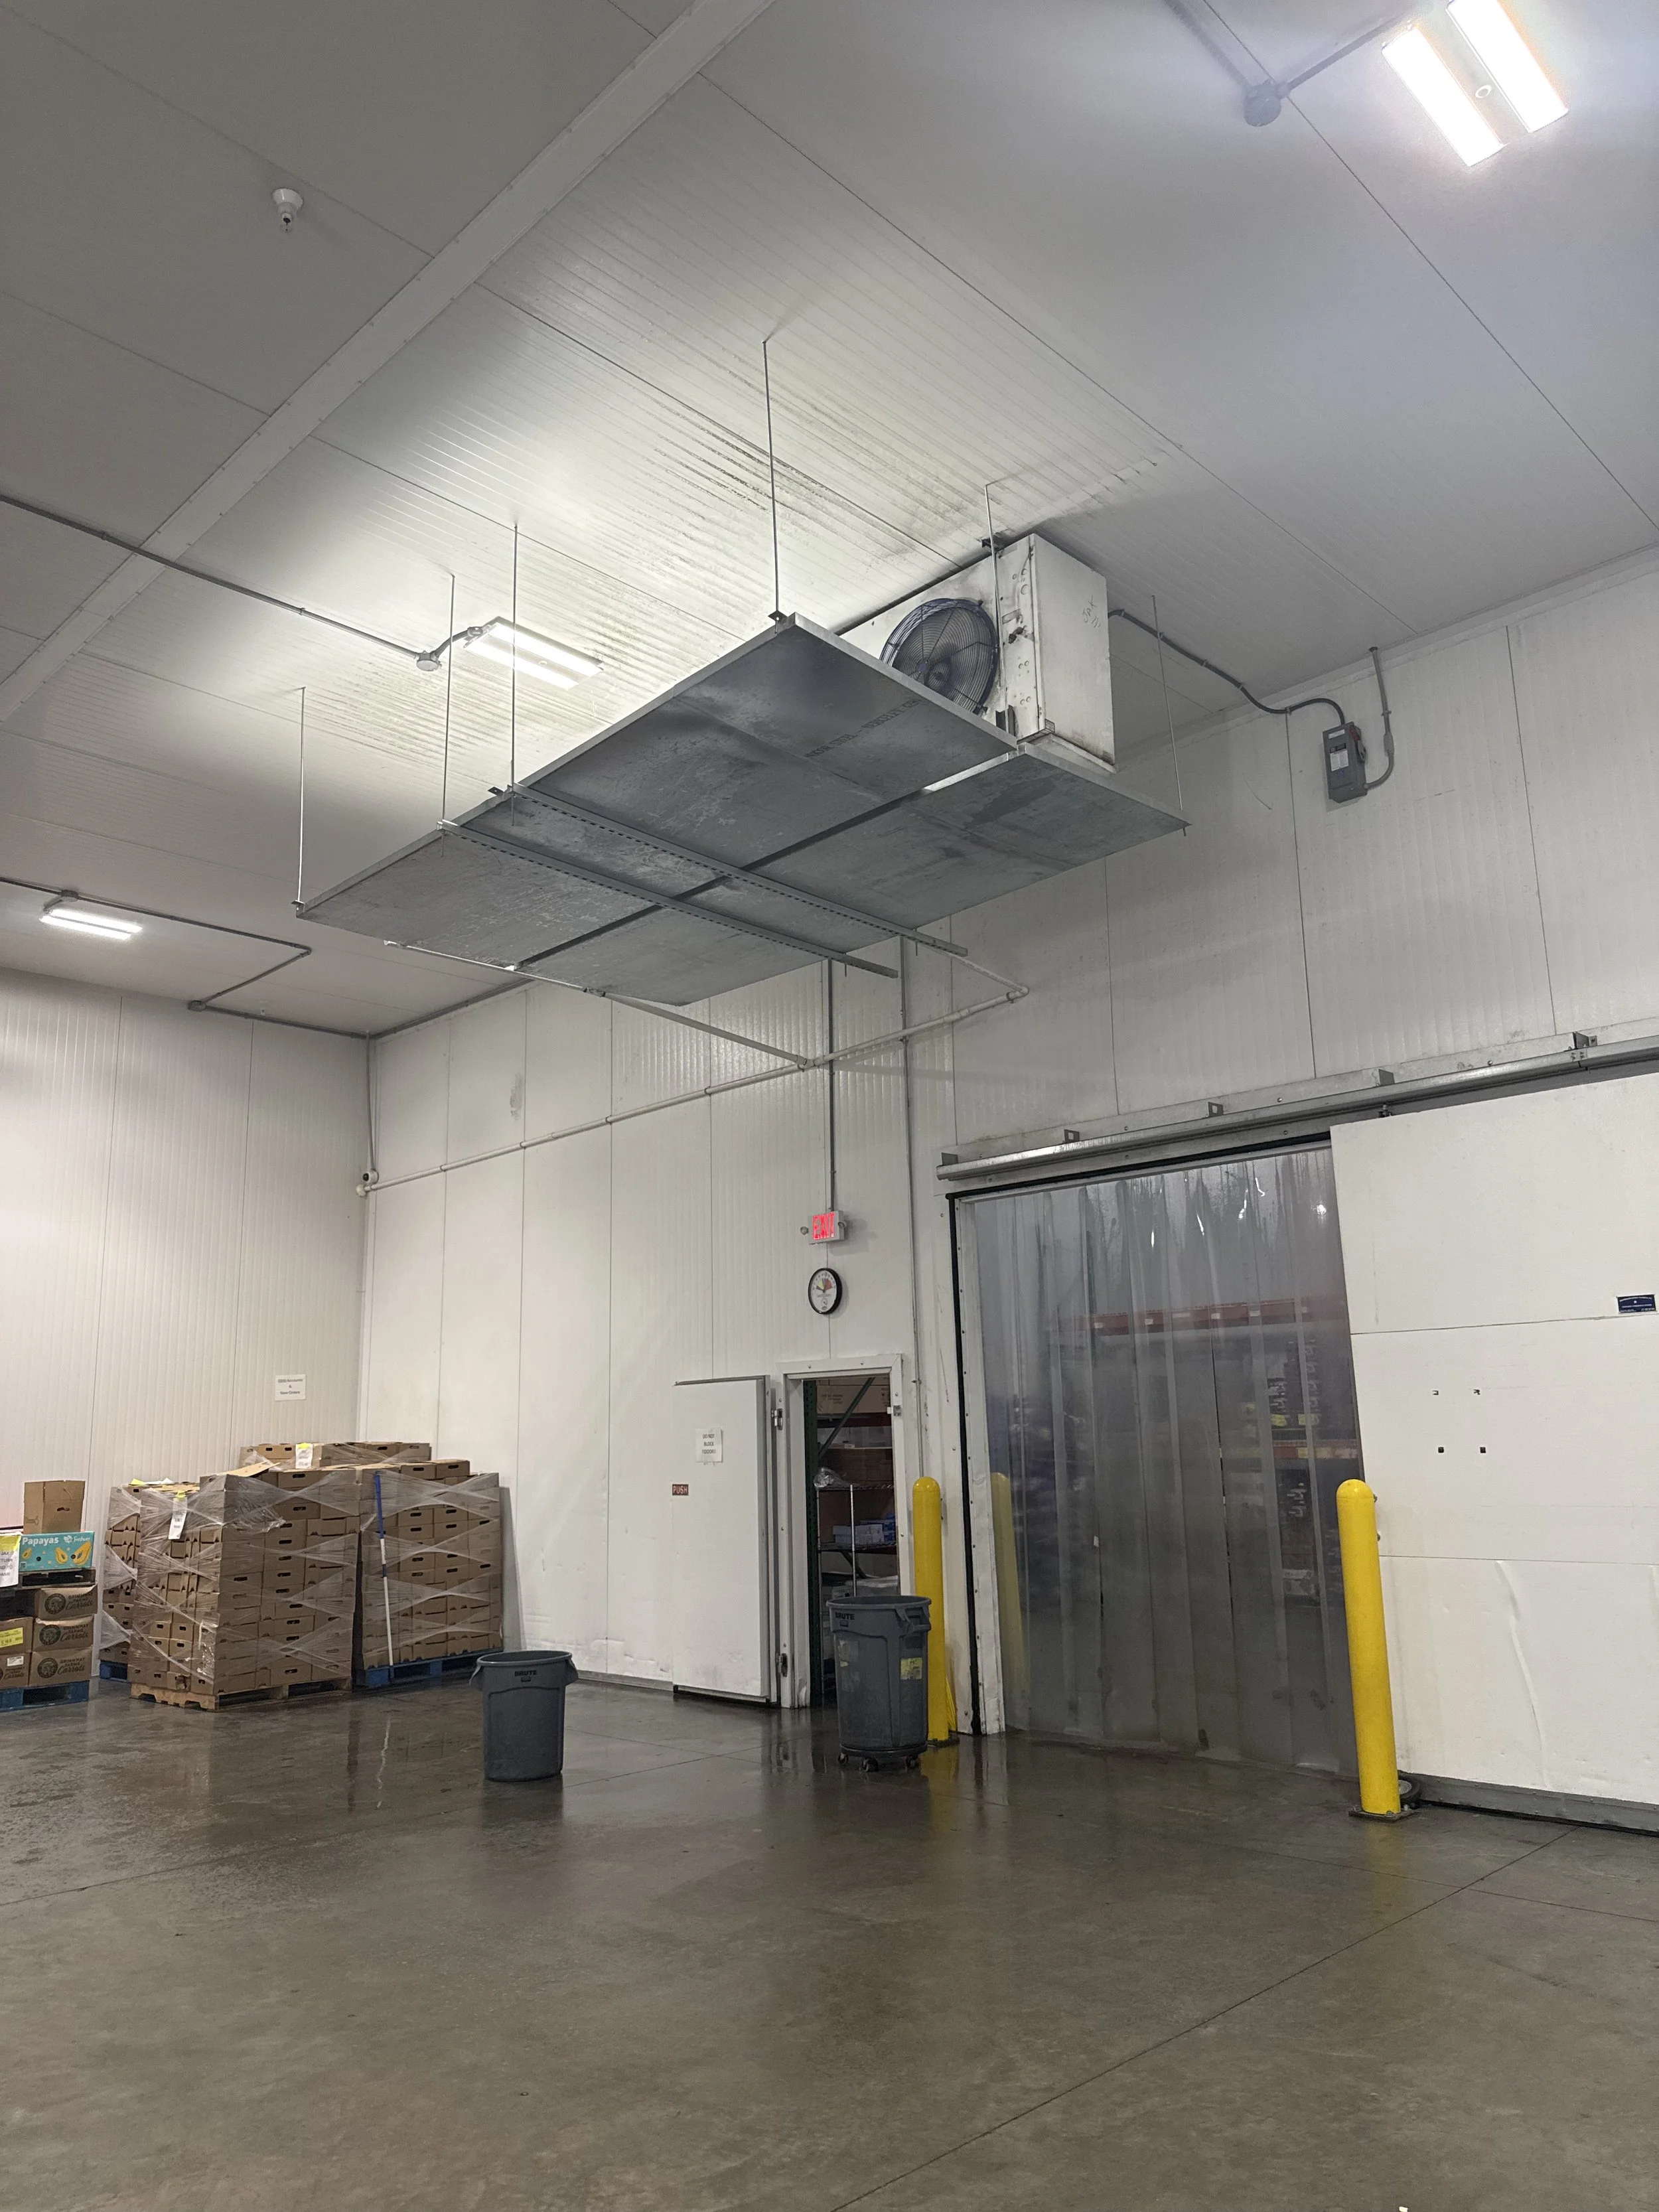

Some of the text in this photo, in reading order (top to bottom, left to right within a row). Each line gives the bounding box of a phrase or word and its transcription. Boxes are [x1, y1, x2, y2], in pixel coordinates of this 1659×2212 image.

[813, 1212, 835, 1240] EXIT
[673, 1485, 688, 1495] PUSH
[22, 1536, 59, 1547] Papayas
